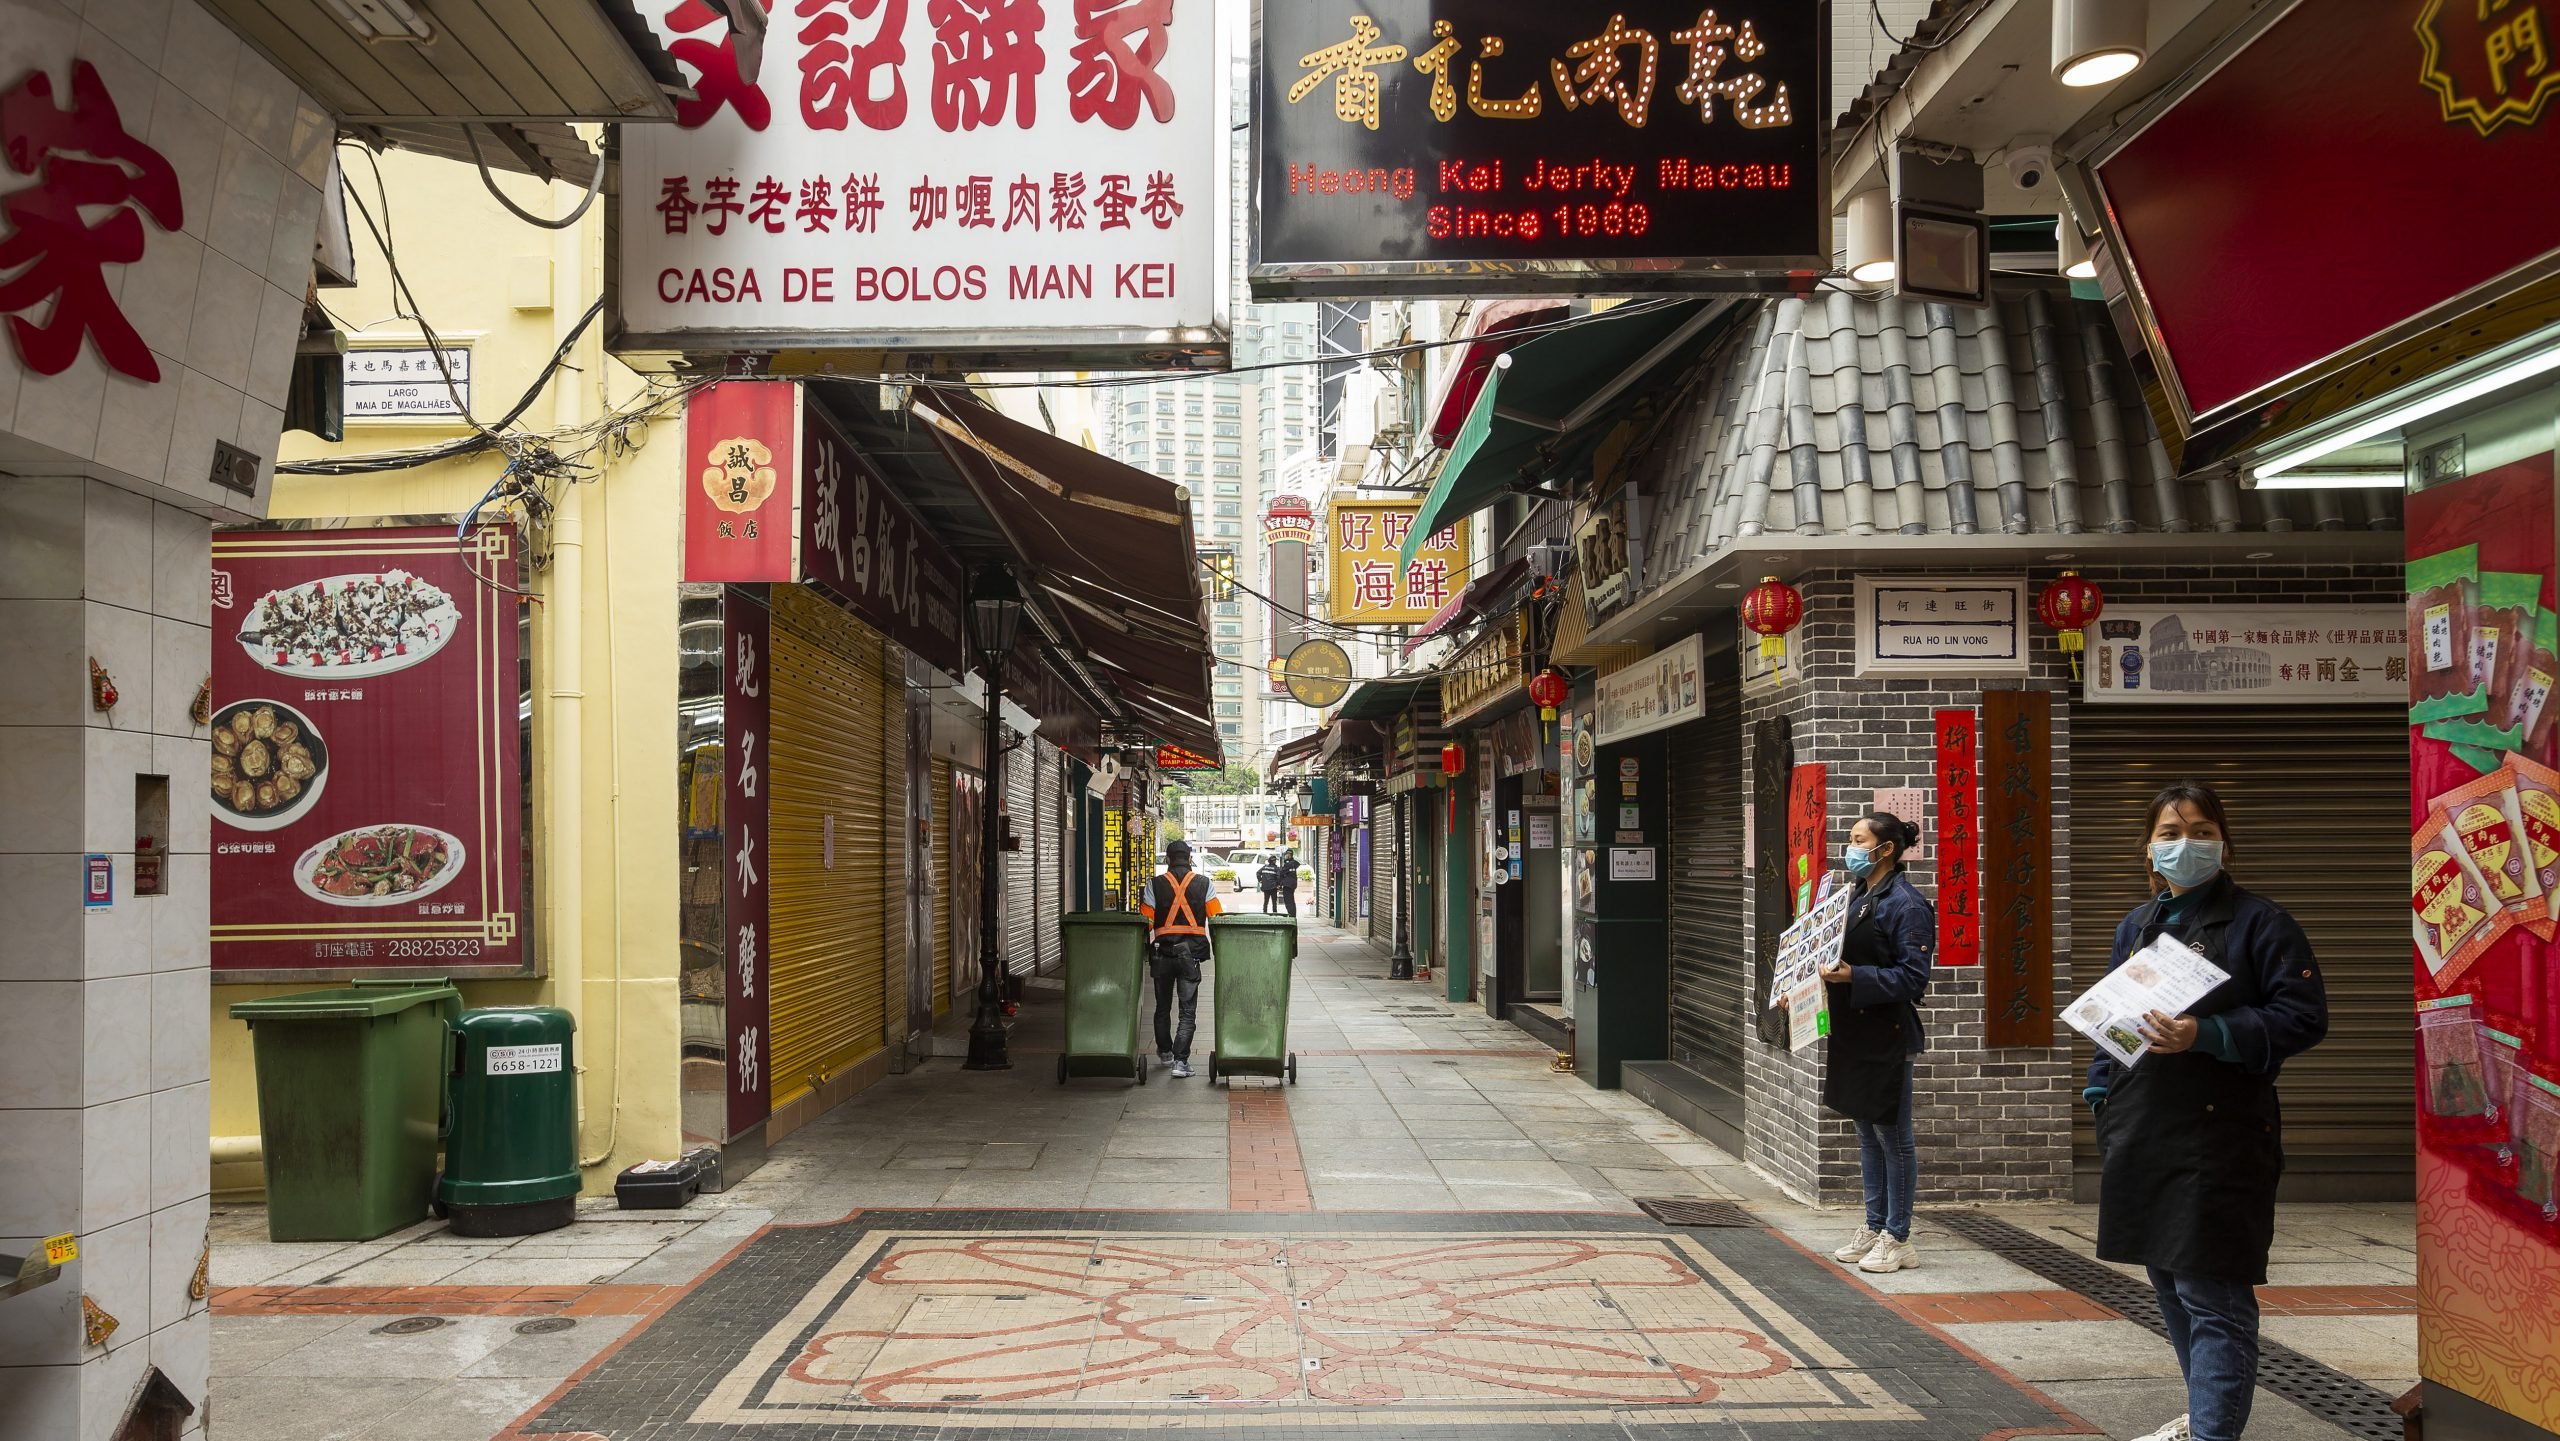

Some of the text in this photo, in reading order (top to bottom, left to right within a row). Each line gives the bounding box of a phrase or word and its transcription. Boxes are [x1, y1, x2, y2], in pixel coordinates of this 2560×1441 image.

[2477, 0, 2548, 96] 門
[1288, 8, 1792, 130] 香記肉乾
[1289, 158, 1791, 200] Heong Kei Jerky Macau
[656, 171, 885, 236] 香芋老婆餅
[1427, 202, 1649, 239] Since 1969
[657, 262, 1175, 303] CASA DE BOLOS MAN KEI
[355, 399, 451, 410] MAIA DE MAGALHÃES
[388, 388, 418, 397] LARGO
[214, 447, 233, 477] 24
[726, 445, 755, 505] 誠昌
[2414, 454, 2432, 481] 19
[716, 519, 760, 541] 飯店
[813, 438, 919, 629] 誠昌飯店
[1352, 558, 1449, 610] 海鮮
[1896, 599, 1996, 613] 何連旺街
[1903, 635, 1989, 645] RUA HO LIN VONG
[2278, 655, 2407, 682] 奪得 兩金一銀
[735, 631, 761, 1094] 馳名水蟹粥
[492, 1058, 559, 1072] 6658-1221
